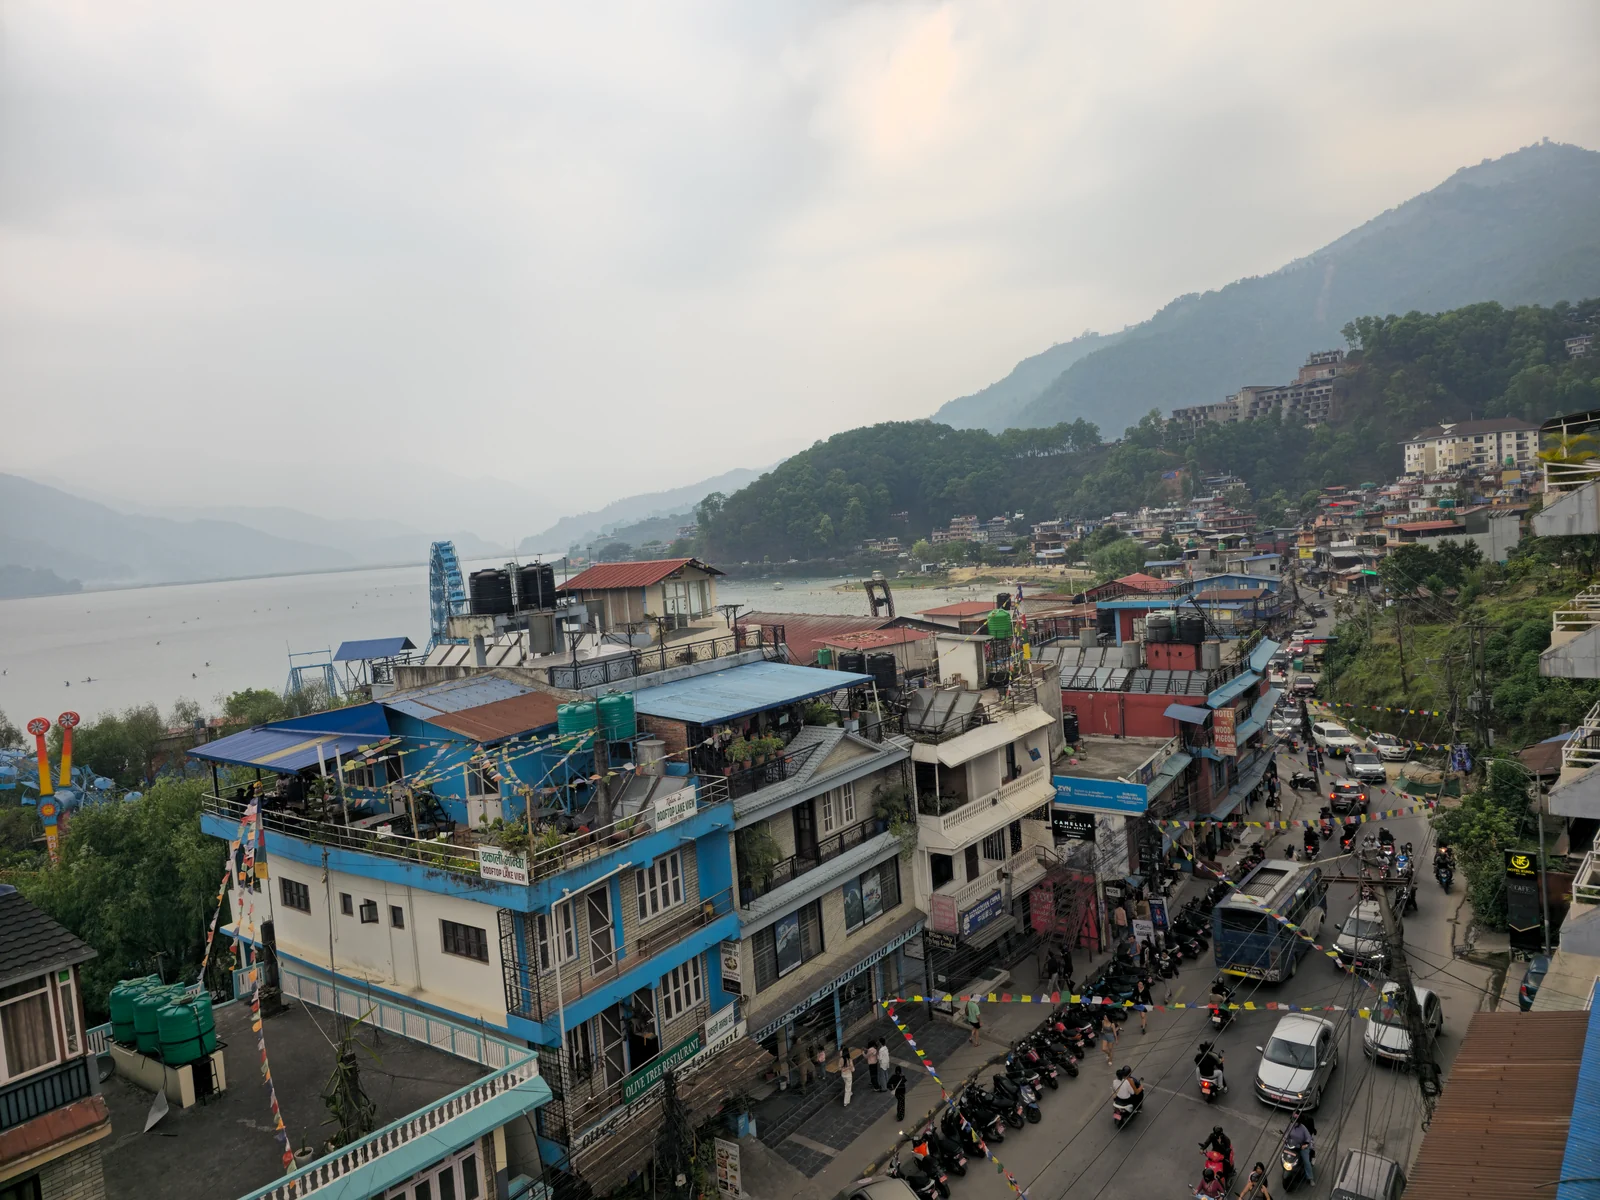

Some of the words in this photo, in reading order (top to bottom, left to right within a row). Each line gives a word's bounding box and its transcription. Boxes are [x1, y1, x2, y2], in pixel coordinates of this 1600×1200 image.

[1213, 710, 1234, 718] HOTEL
[1215, 726, 1231, 734] WOOD
[1215, 734, 1236, 743] PIGEON
[656, 806, 675, 822] ROOFTOP
[675, 802, 685, 815] LAKE
[685, 798, 695, 811] VIEW
[1053, 819, 1092, 829] CAMELLIA
[483, 865, 502, 877] ROOFTOP
[502, 869, 514, 880] LAKE
[514, 871, 526, 882] VIEW
[817, 945, 889, 998] Paragliding
[625, 1076, 646, 1098] OLIVE
[645, 1064, 663, 1084] TREE
[662, 1037, 700, 1073] RESTAURANT
